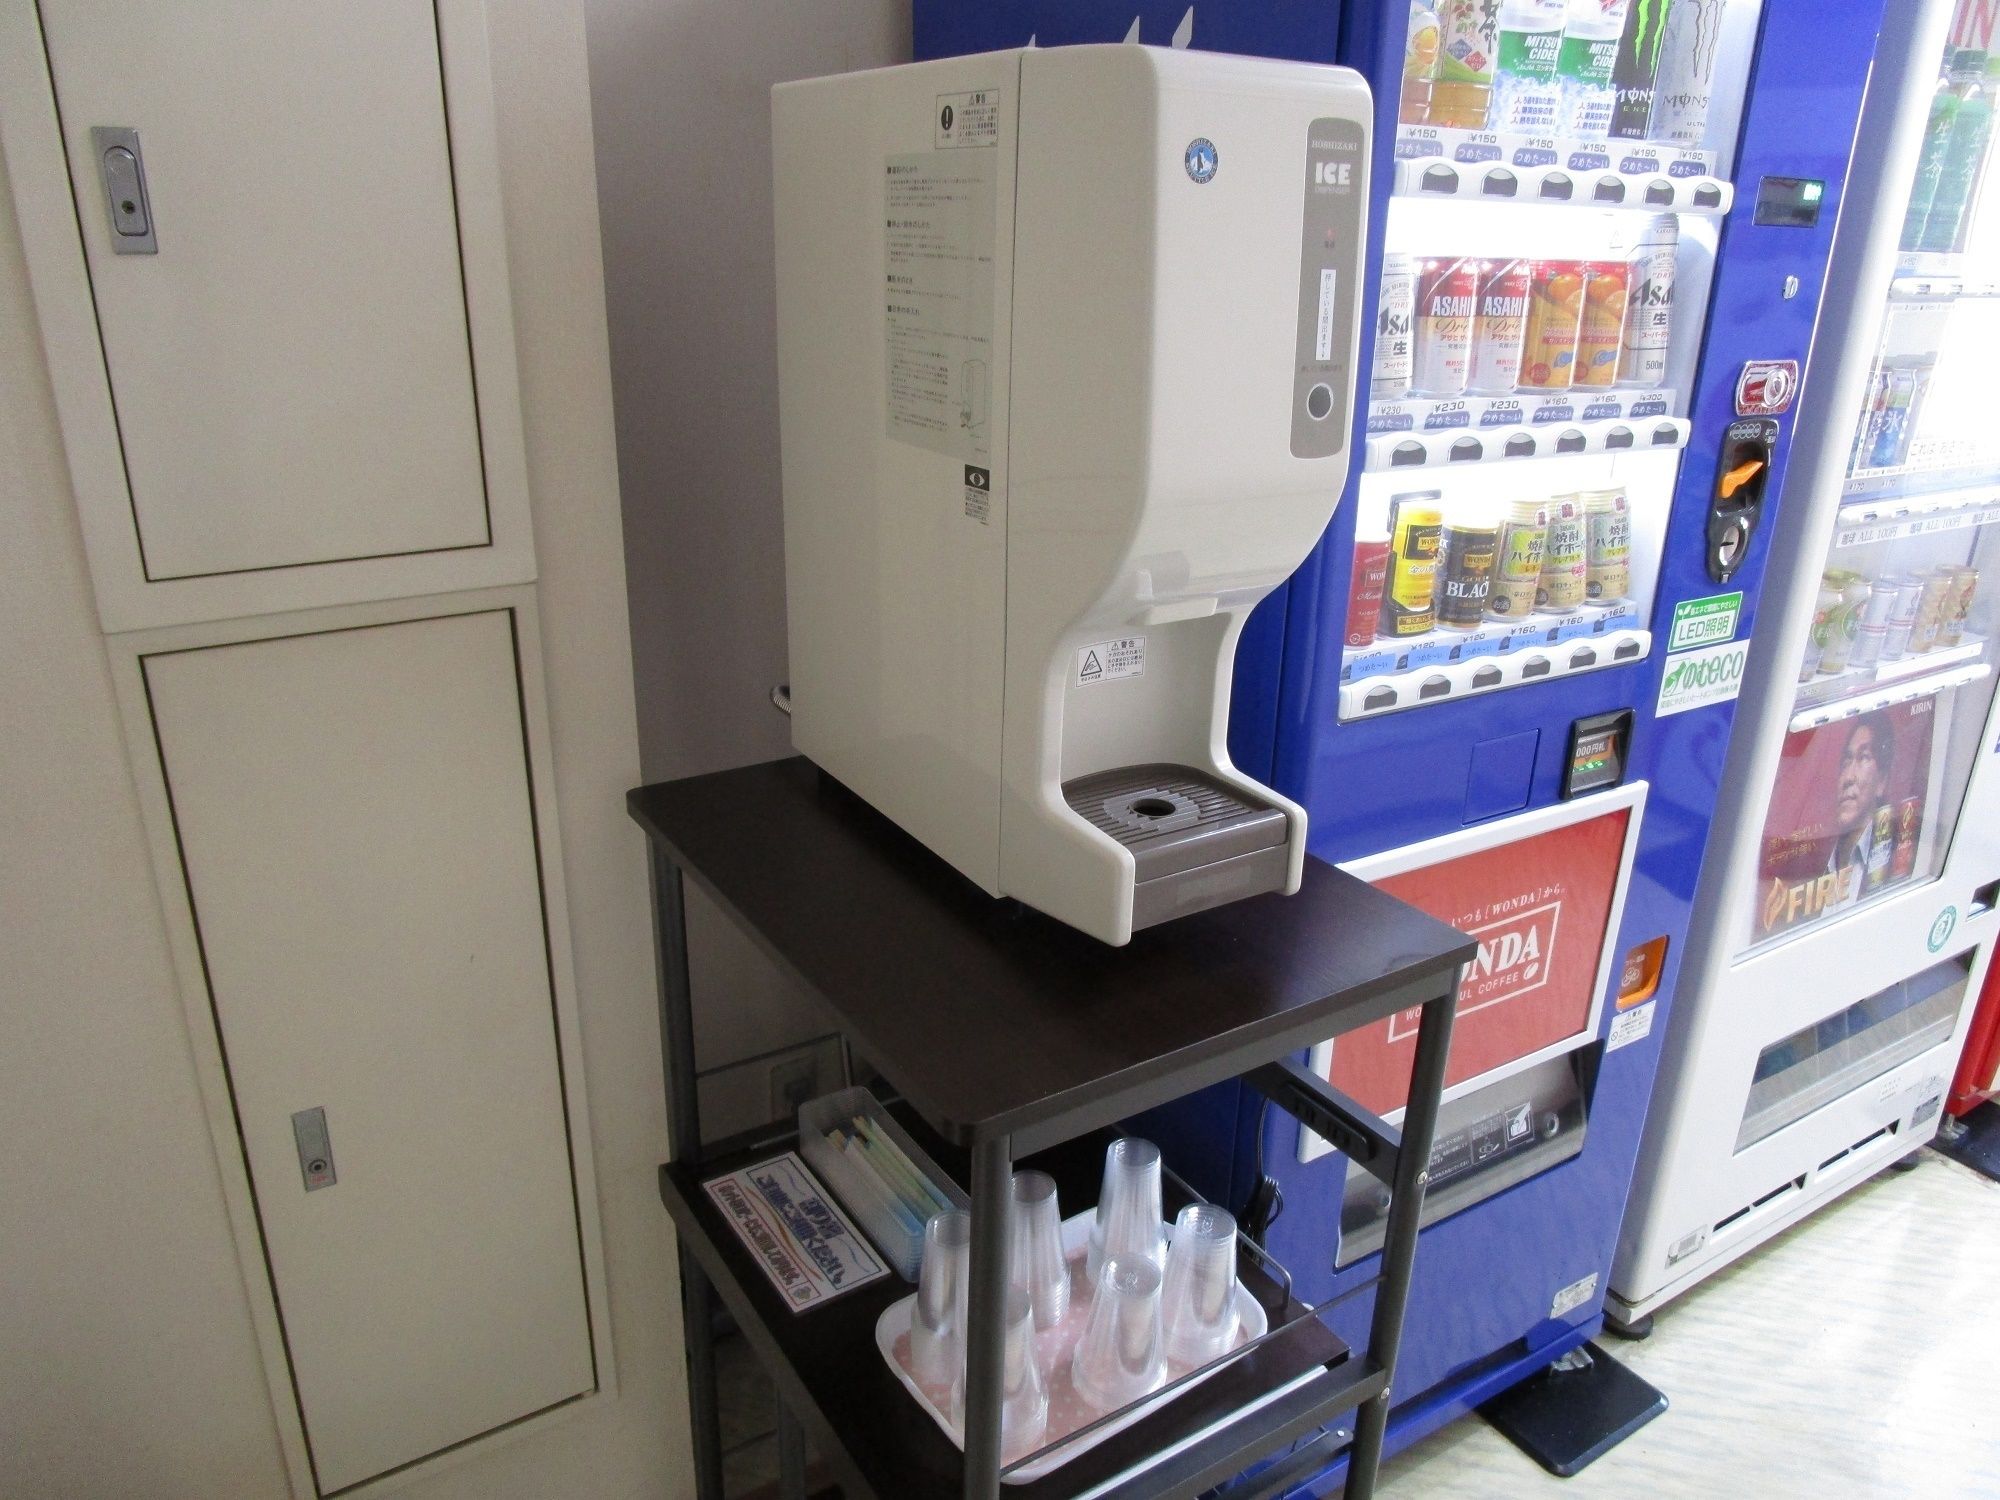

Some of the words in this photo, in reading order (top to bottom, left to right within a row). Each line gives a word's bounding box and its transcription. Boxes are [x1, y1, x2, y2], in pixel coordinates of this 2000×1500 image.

[1408, 128, 1437, 139] ¥150
[1470, 133, 1497, 144] ¥150
[1311, 140, 1358, 151] HOSHIZAKI
[1528, 138, 1554, 148] ¥150
[1582, 143, 1607, 153] ¥150
[1925, 120, 1951, 178] 生茶
[1315, 162, 1351, 184] ICE
[1653, 312, 1668, 326] 生
[1392, 341, 1408, 356] 生
[1544, 397, 1568, 405] ¥160
[1594, 395, 1616, 403] ¥160
[1380, 406, 1402, 415] ¥230
[1434, 401, 1465, 413] ¥230
[1490, 401, 1519, 411] ¥230
[1925, 519, 1939, 531] ALL
[1555, 532, 1579, 544] 焼酎
[1858, 529, 1874, 542] ALL
[1601, 606, 1626, 619] ¥160
[1559, 616, 1584, 626] ¥160
[1510, 625, 1536, 636] ¥160
[1678, 614, 1731, 641] LED照明
[1463, 632, 1486, 643] ¥120
[1411, 641, 1435, 651] ¥120
[1910, 701, 1932, 716] KIRIN
[1786, 865, 1854, 923] FIRE
[1478, 972, 1519, 995] COFFEE
